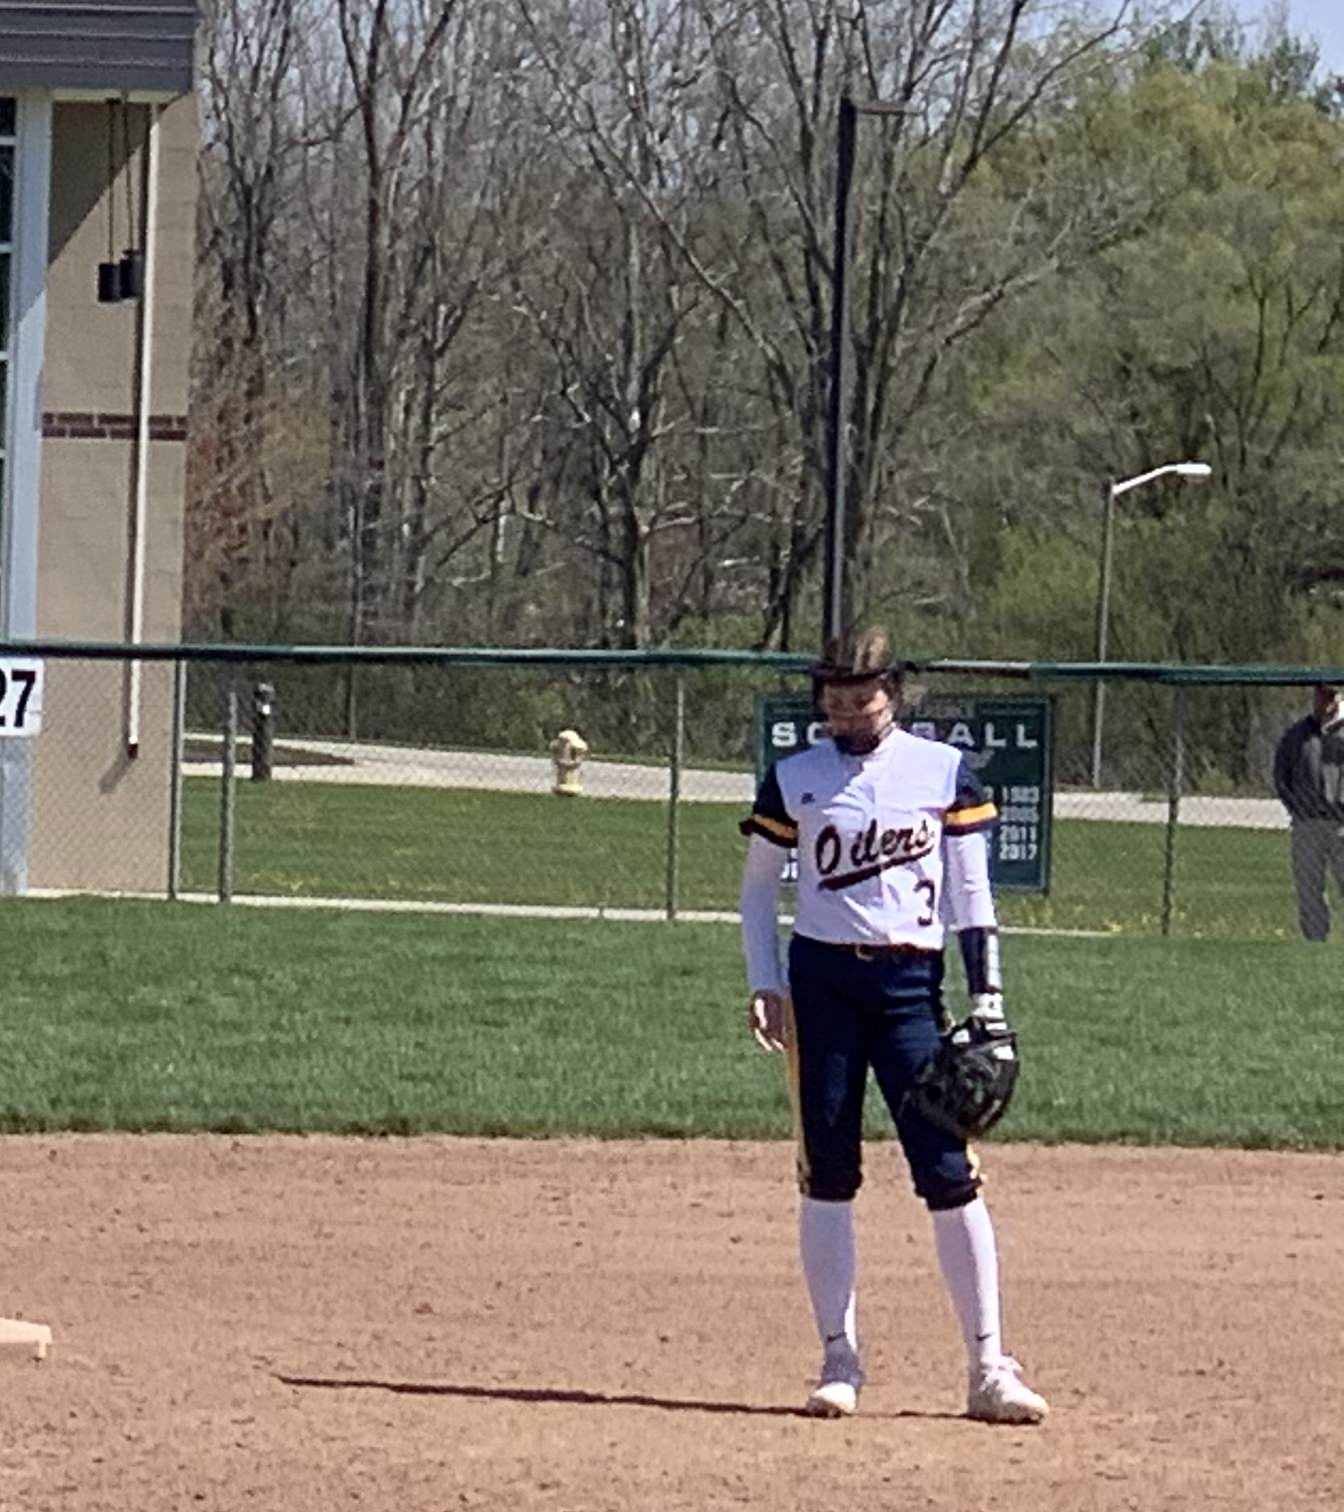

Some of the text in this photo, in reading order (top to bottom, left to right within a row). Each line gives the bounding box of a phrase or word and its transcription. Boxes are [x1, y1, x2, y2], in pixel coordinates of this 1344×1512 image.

[771, 721, 1038, 747] SOBALL
[816, 818, 934, 875] Oilers
[1000, 826, 1037, 842] 2011
[1000, 843, 1038, 860] 2017
[913, 879, 935, 927] 3
